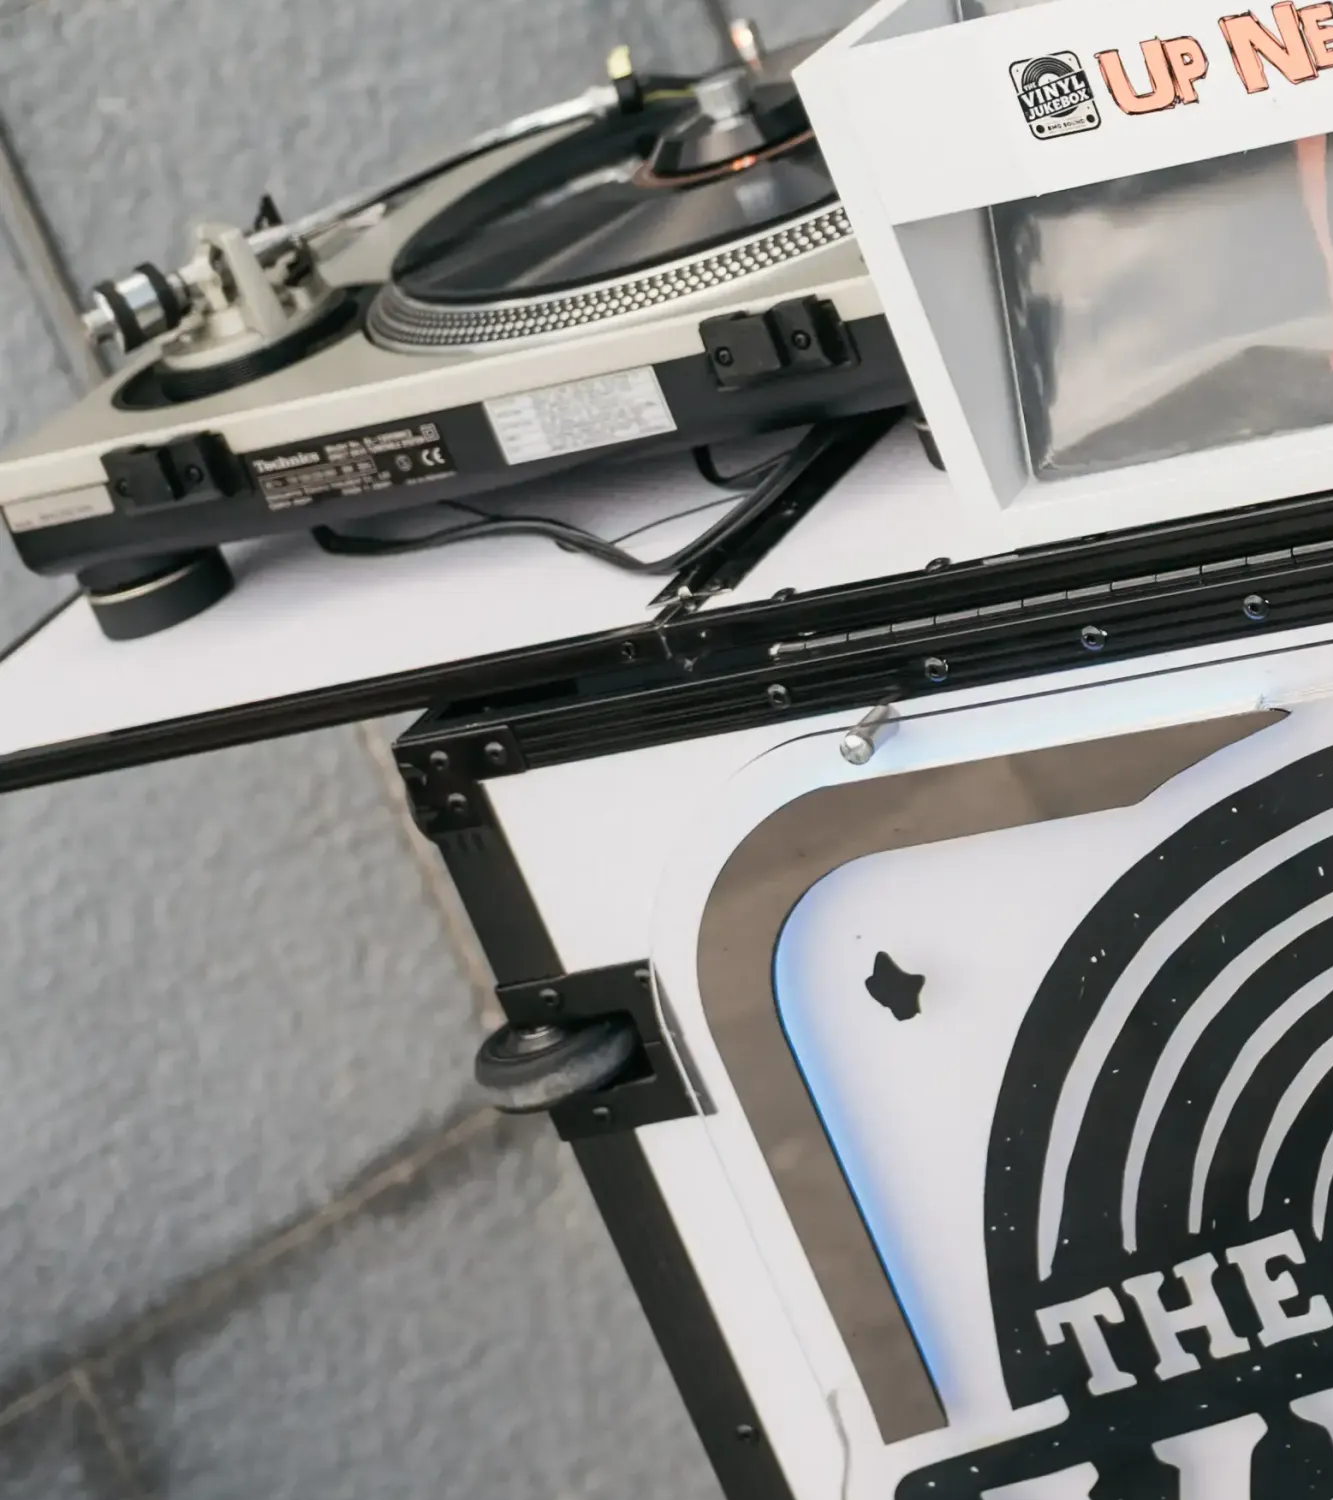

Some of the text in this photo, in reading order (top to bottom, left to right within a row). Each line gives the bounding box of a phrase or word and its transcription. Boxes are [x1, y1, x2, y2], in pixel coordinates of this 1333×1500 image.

[1020, 74, 1086, 108] VINYL
[1093, 36, 1209, 116] UP
[1028, 88, 1090, 120] JUKEBOX
